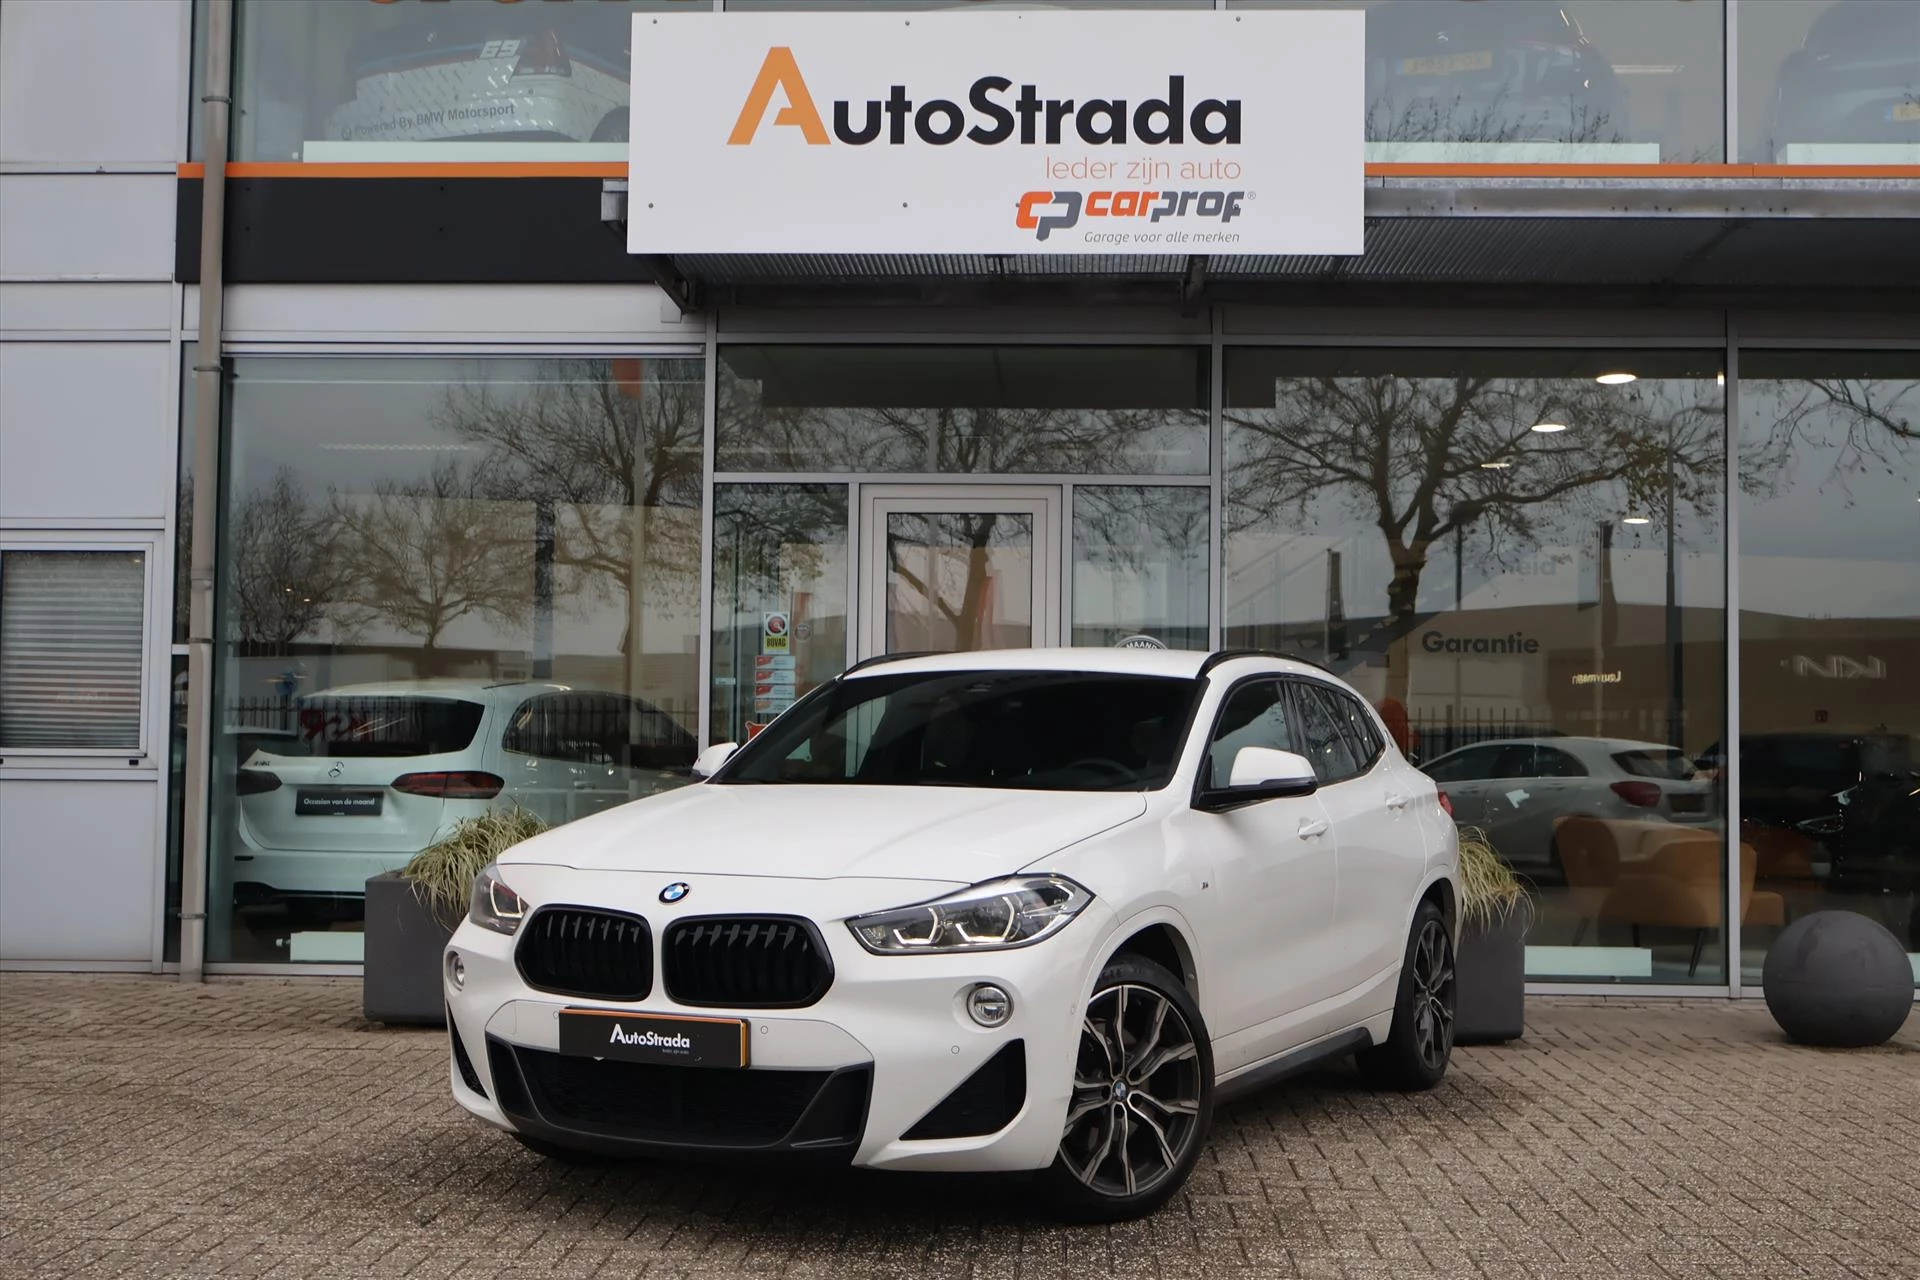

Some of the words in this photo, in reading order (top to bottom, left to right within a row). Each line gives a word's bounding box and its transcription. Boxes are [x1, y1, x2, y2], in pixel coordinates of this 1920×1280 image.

[480, 39, 521, 58] 69
[726, 46, 1242, 145] AutoStrada
[400, 116, 413, 130] By
[416, 111, 445, 126] BMW
[448, 103, 516, 121] Motorsport
[1046, 157, 1118, 180] Ieder
[1127, 157, 1170, 185] zijn
[1180, 159, 1242, 180] auto
[1085, 191, 1245, 223] carprof
[1084, 231, 1129, 246] Garage
[1134, 234, 1162, 243] voor
[1165, 231, 1190, 243] alle
[1193, 231, 1241, 243] merken
[1422, 631, 1540, 654] Garantie
[353, 798, 375, 806] maand
[610, 1023, 690, 1048] AutoStrada
